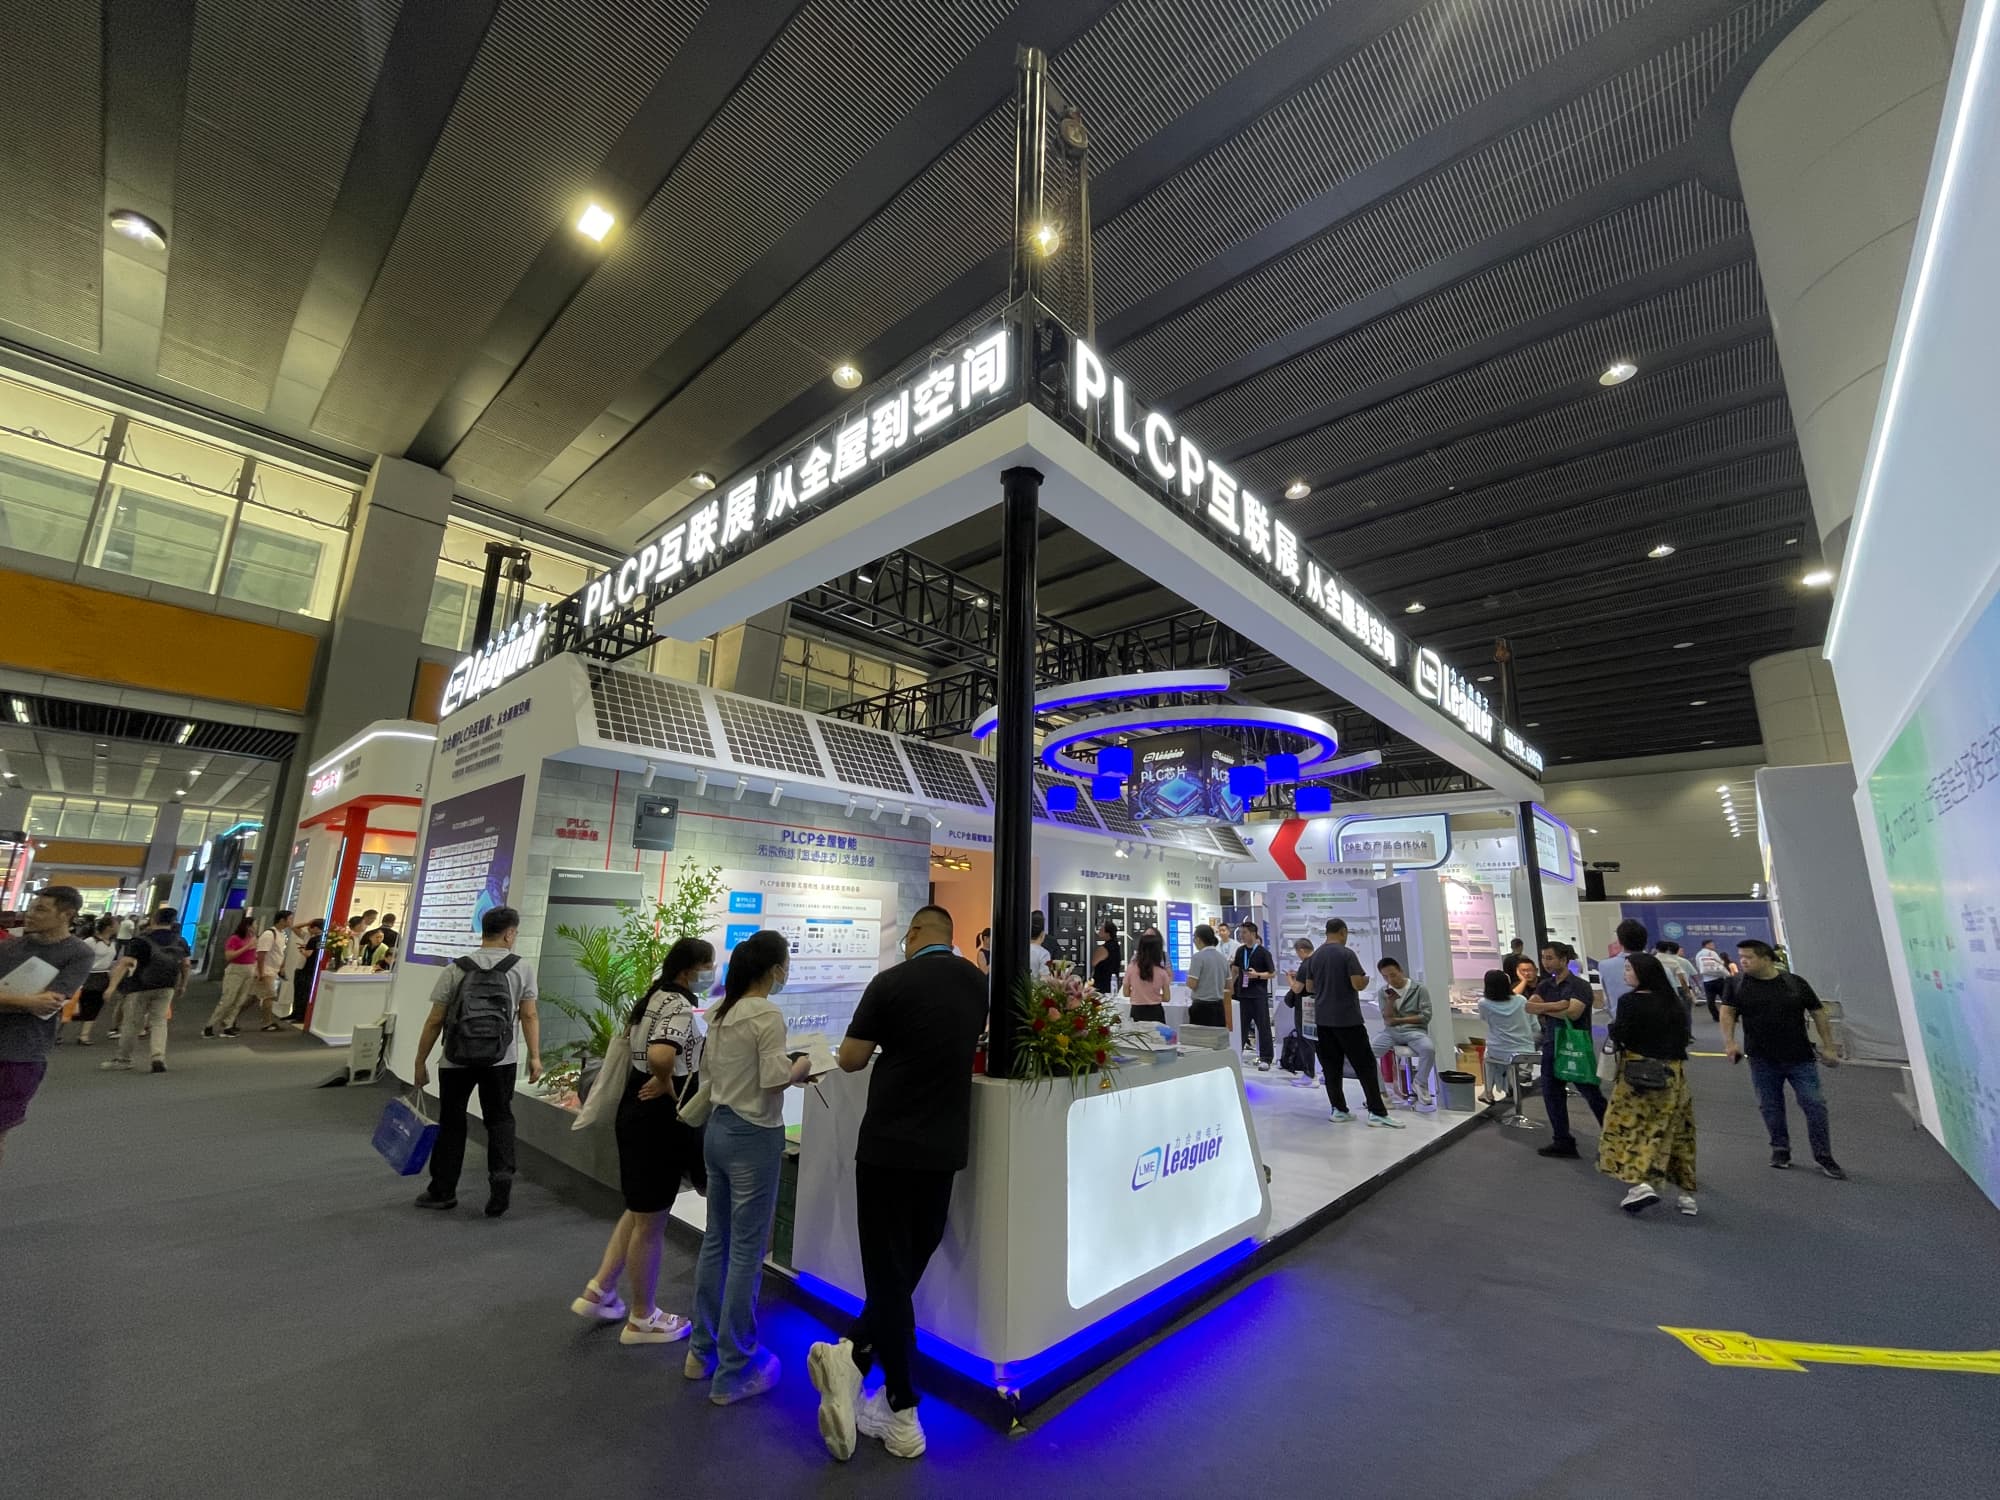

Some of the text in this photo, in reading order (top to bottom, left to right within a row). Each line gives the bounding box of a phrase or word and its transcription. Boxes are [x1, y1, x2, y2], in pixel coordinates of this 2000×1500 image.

[583, 328, 1009, 627] PLCP互联展 从全屋到空间
[1075, 338, 1398, 667] PLCP互联展 从全屋到空间
[1140, 765, 1188, 783] PLC芯片
[567, 817, 591, 829] PLC
[781, 829, 858, 851] PLCP全屋智能
[1139, 1135, 1223, 1178] LME Leaguer
